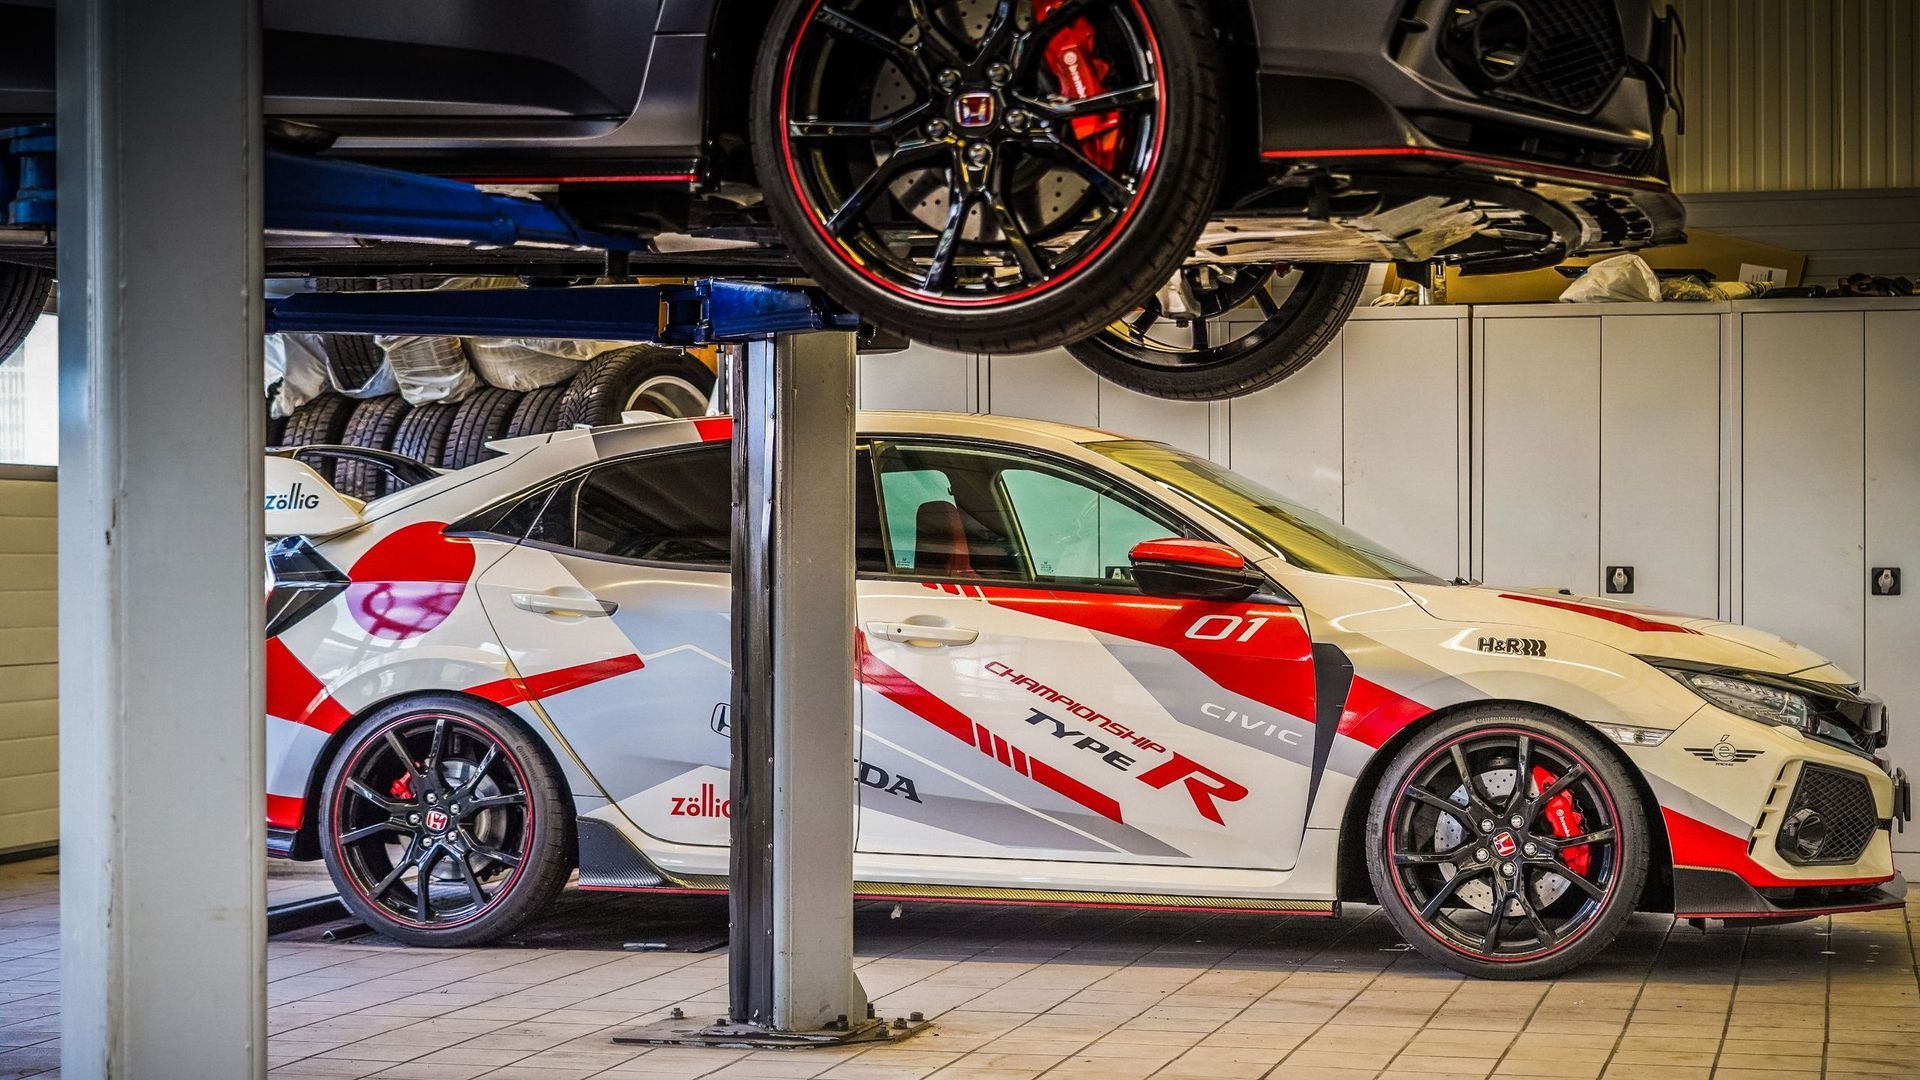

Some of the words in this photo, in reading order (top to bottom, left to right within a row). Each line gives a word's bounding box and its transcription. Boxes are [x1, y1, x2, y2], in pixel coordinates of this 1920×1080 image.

[1185, 614, 1269, 642] 01
[984, 661, 1166, 754] CHAMPIONSHIP
[1201, 702, 1303, 746] CIVIC
[1025, 707, 1137, 772] TYPE
[1136, 751, 1249, 827] R
